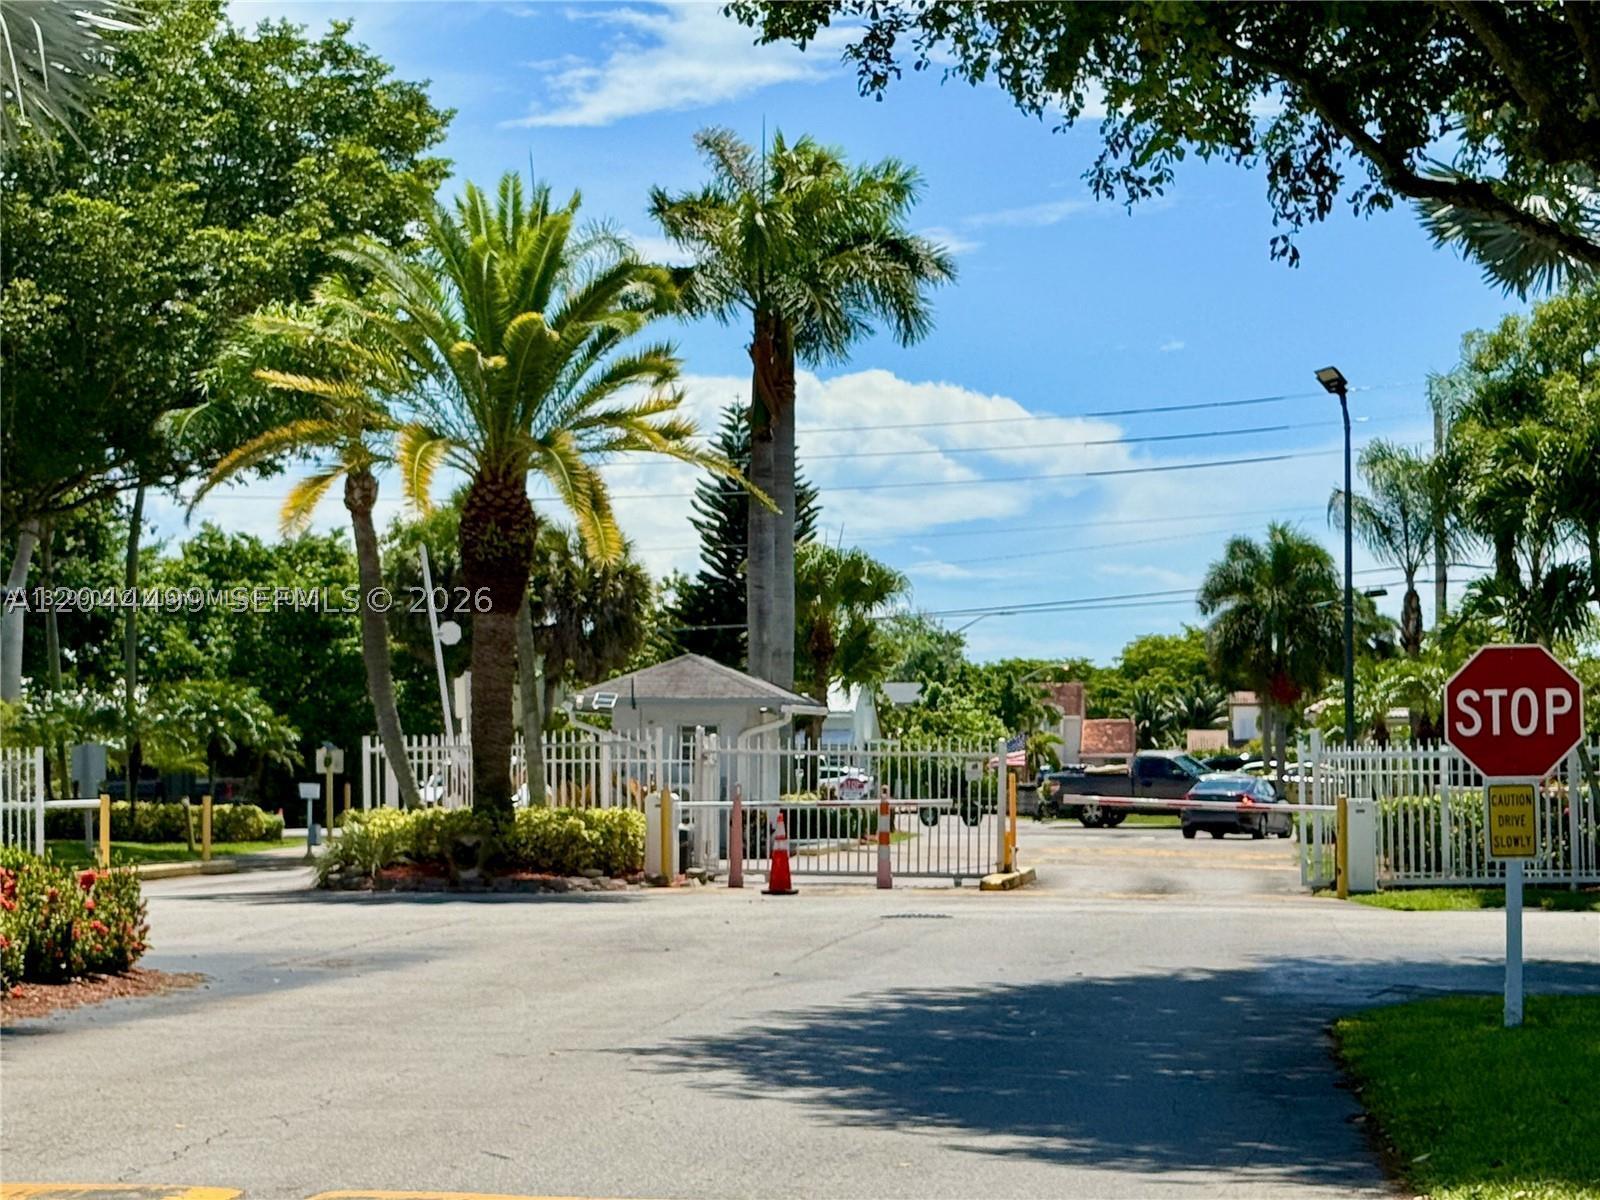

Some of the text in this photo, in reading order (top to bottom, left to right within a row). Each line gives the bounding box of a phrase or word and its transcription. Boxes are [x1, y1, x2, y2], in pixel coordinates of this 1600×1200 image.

[1455, 687, 1572, 736] STOP
[1491, 793, 1532, 806] CAUTION
[1498, 814, 1526, 827] DRIVE
[1494, 835, 1531, 848] SLOWLY
